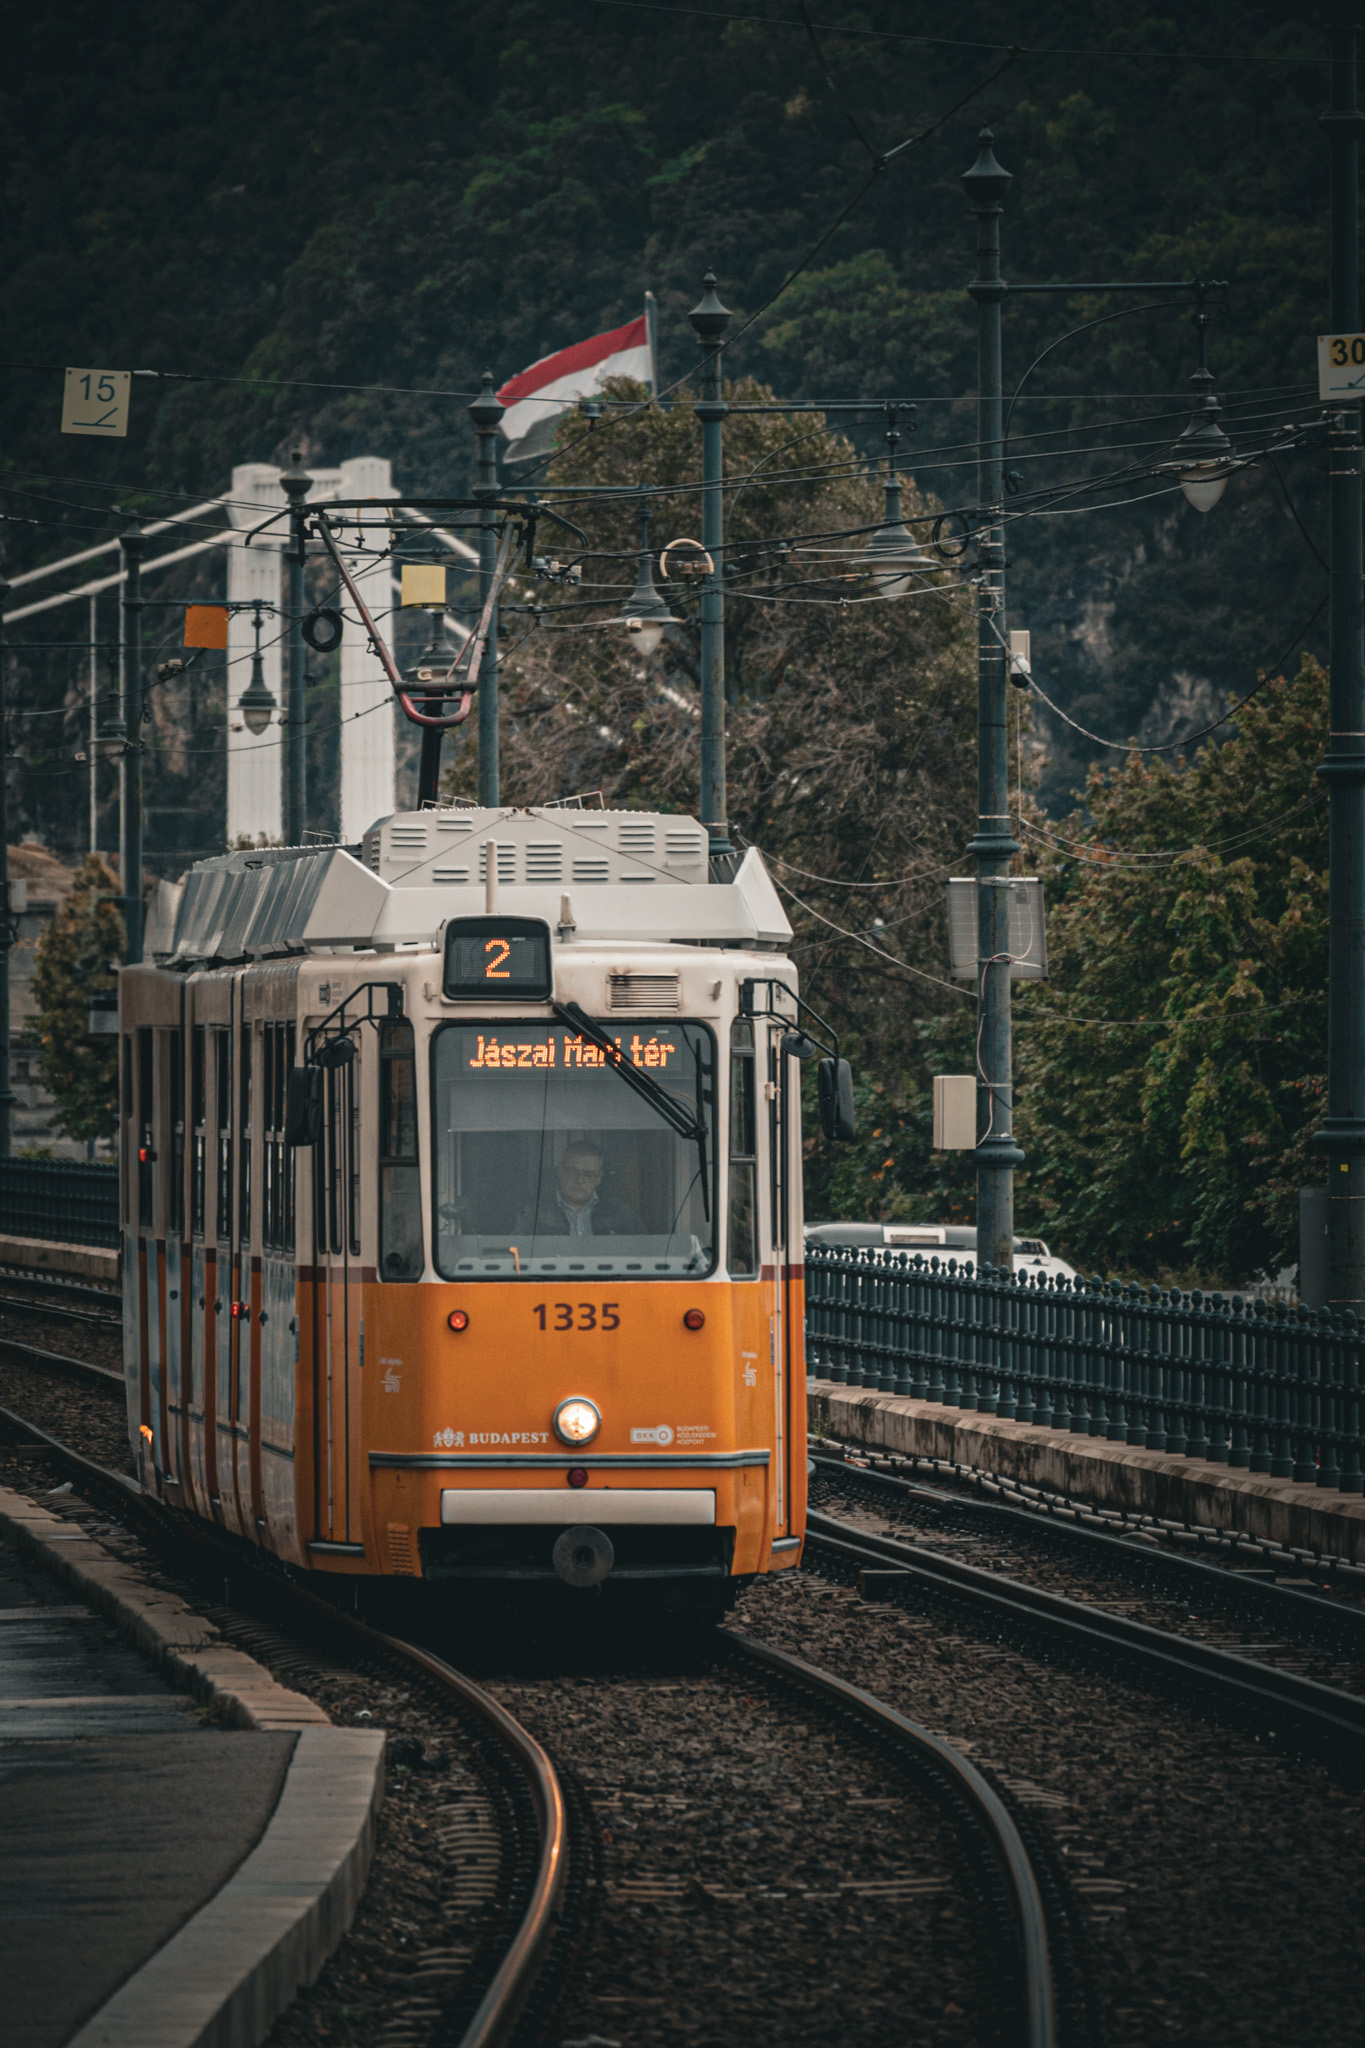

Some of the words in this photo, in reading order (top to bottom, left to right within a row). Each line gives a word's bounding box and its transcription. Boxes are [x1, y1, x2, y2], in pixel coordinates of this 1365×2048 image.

[1332, 338, 1365, 366] 30
[80, 373, 115, 402] 15
[485, 939, 510, 978] 2
[469, 1035, 555, 1067] Jászai
[630, 1035, 675, 1067] tér
[533, 1303, 620, 1331] 1335
[469, 1432, 549, 1444] BUDAPEST
